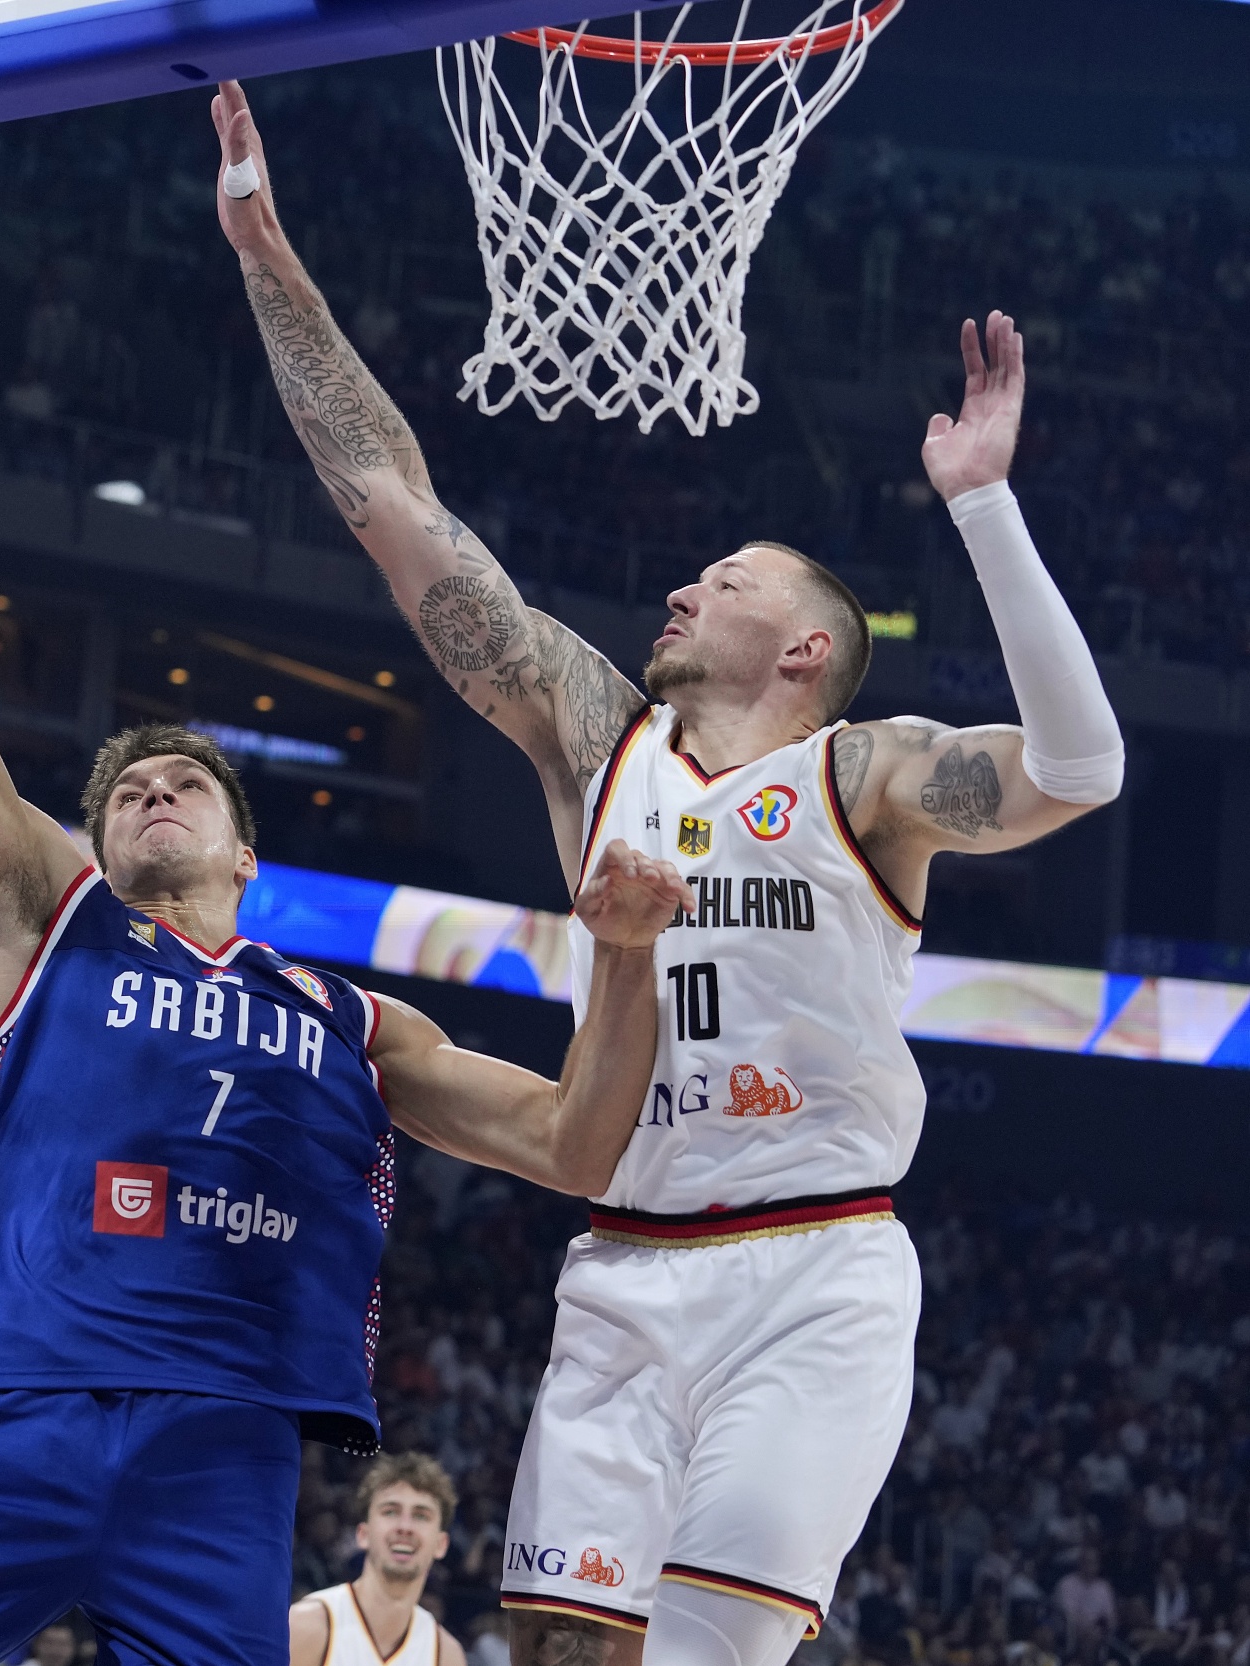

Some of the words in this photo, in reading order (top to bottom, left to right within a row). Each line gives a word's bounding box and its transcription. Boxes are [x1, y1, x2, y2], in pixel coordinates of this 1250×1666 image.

[106, 970, 325, 1079] SRBIJA
[666, 961, 721, 1042] 10
[201, 1069, 235, 1137] 7
[636, 1073, 711, 1128] NG
[177, 1185, 298, 1244] triglav
[507, 1542, 567, 1576] ING
